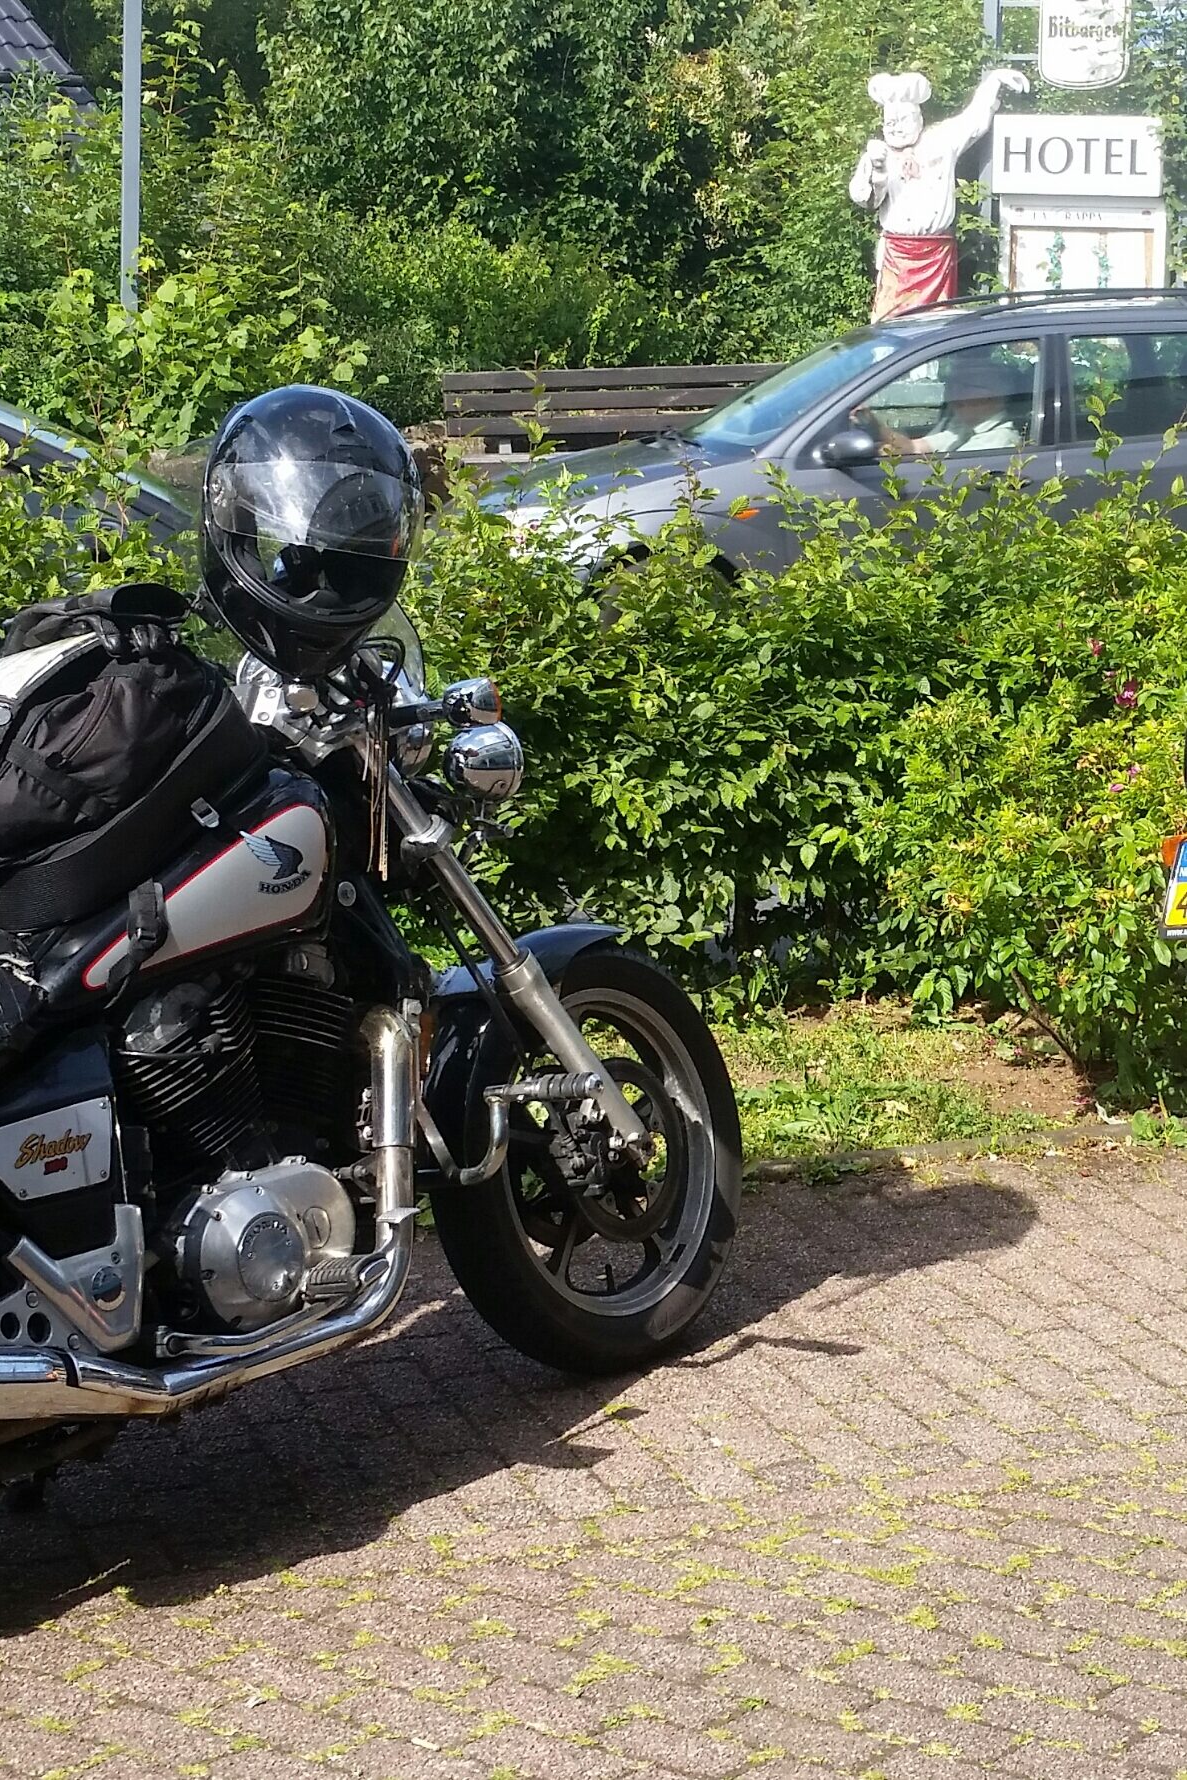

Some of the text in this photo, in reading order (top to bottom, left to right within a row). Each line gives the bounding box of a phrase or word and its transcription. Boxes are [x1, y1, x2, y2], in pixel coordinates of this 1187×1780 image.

[1003, 136, 1148, 176] HOTEL
[258, 869, 312, 895] HONDA
[14, 1128, 92, 1169] Shadow
